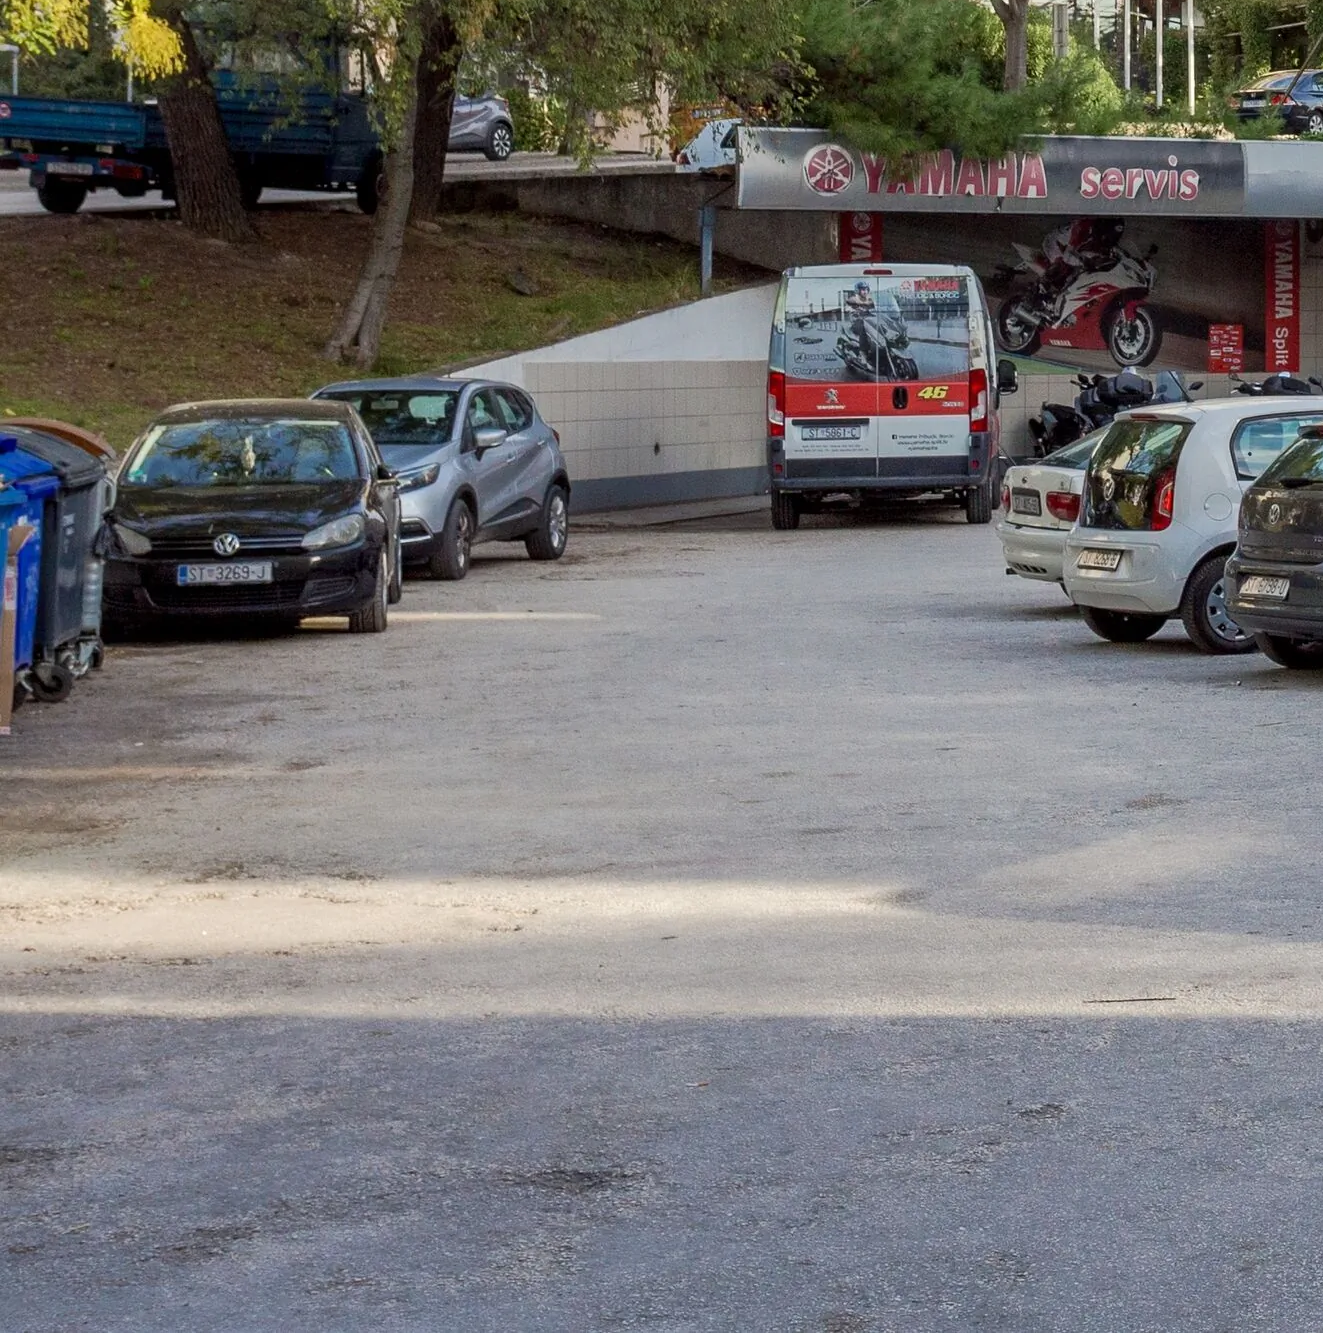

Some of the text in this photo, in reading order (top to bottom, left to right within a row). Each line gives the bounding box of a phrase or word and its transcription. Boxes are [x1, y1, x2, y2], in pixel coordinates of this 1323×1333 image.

[1081, 154, 1200, 200] servis
[1272, 240, 1294, 366] YAMAHA Split
[917, 385, 949, 399] 46
[190, 567, 205, 581] ST
